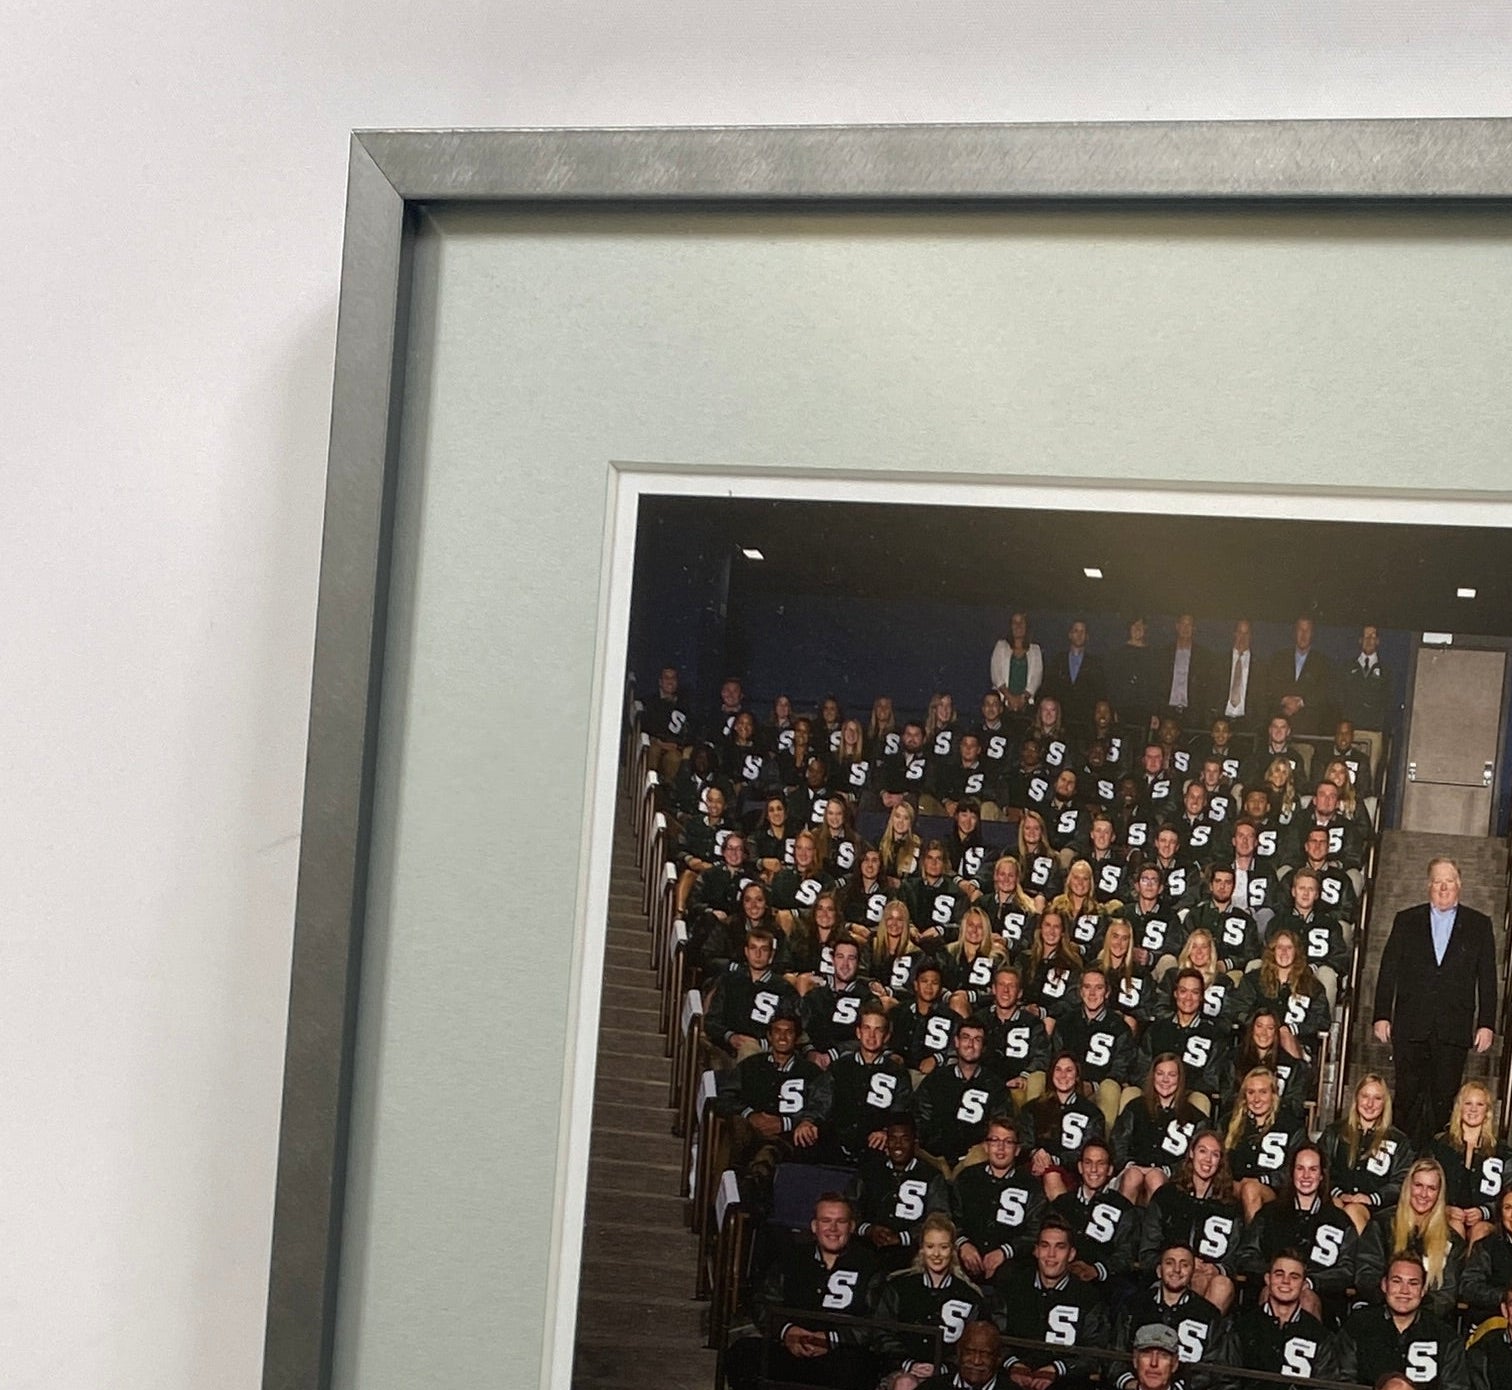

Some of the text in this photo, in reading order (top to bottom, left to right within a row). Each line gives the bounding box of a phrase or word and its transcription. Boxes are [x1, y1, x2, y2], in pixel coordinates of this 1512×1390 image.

[669, 711, 685, 733] S
[885, 734, 899, 754] S
[934, 731, 952, 755] S
[988, 737, 1006, 758] S
[1047, 742, 1065, 765] S
[743, 755, 762, 779] S
[849, 761, 868, 785] S
[906, 759, 925, 779] S
[1175, 752, 1189, 771] S
[1222, 760, 1239, 779] S
[966, 775, 983, 792] S
[1029, 779, 1047, 801] S
[1098, 780, 1114, 799] S
[1152, 781, 1169, 798] S
[1058, 811, 1077, 832] S
[1209, 797, 1228, 821] S
[1128, 823, 1146, 845] S
[1190, 826, 1211, 846] S
[1258, 832, 1276, 855] S
[838, 842, 854, 867] S
[965, 848, 981, 875] S
[1032, 857, 1052, 884] S
[1100, 866, 1120, 892] S
[1168, 869, 1186, 896] S
[796, 880, 821, 904] S
[1249, 879, 1267, 906] S
[1321, 878, 1341, 904] S
[867, 895, 886, 921] S
[932, 895, 954, 923] S
[1003, 913, 1024, 941] S
[1075, 915, 1098, 941] S
[1143, 921, 1166, 949] S
[1224, 918, 1245, 945] S
[1308, 928, 1329, 957] S
[891, 957, 911, 986] S
[970, 958, 992, 984] S
[1042, 966, 1070, 998] S
[1118, 977, 1142, 1007] S
[1204, 986, 1224, 1015] S
[751, 992, 778, 1023] S
[833, 997, 860, 1024] S
[1285, 996, 1310, 1024] S
[925, 1017, 950, 1049] S
[1006, 1028, 1029, 1058] S
[1087, 1033, 1113, 1065] S
[1184, 1037, 1210, 1066] S
[779, 1079, 804, 1112] S
[867, 1073, 896, 1108] S
[958, 1089, 988, 1123] S
[1062, 1113, 1088, 1149] S
[1161, 1120, 1194, 1156] S
[1258, 1132, 1288, 1169] S
[1367, 1140, 1397, 1176] S
[1480, 1157, 1503, 1196] S
[896, 1180, 927, 1220] S
[997, 1188, 1027, 1225] S
[1086, 1204, 1121, 1242] S
[1199, 1216, 1232, 1258] S
[1311, 1225, 1343, 1266] S
[822, 1270, 858, 1309] S
[939, 1300, 972, 1343] S
[1045, 1305, 1079, 1346] S
[1177, 1319, 1208, 1363] S
[1281, 1338, 1316, 1378] S
[1406, 1342, 1437, 1382] S
